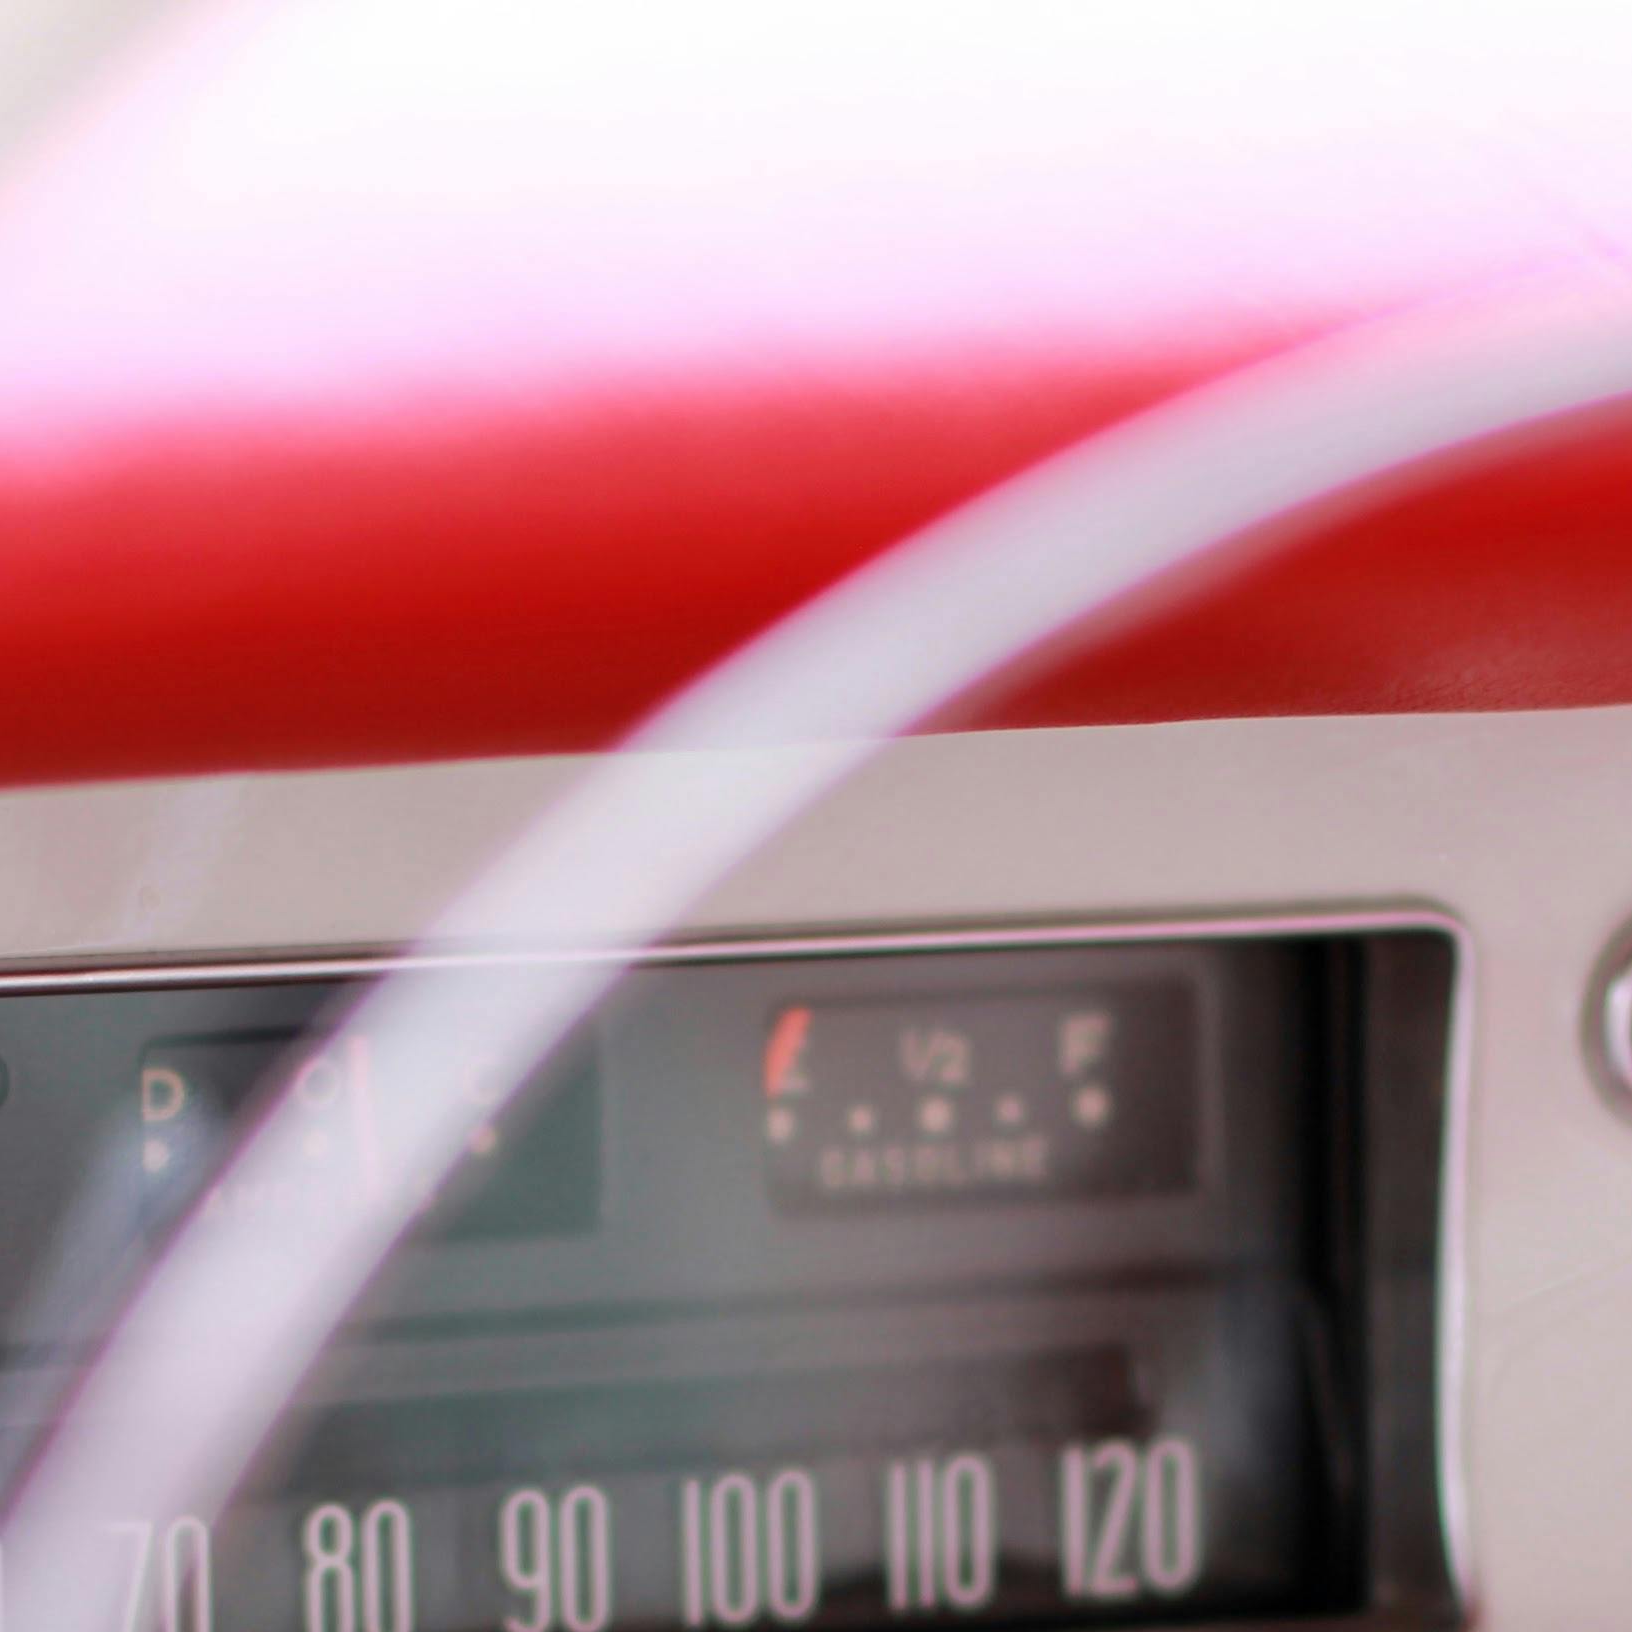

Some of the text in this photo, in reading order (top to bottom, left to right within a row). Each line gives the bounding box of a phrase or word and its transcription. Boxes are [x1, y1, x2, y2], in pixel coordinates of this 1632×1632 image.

[141, 1067, 186, 1122] D
[681, 1468, 819, 1628] 100
[887, 1452, 996, 1612] 110
[1060, 1438, 1199, 1598] 120
